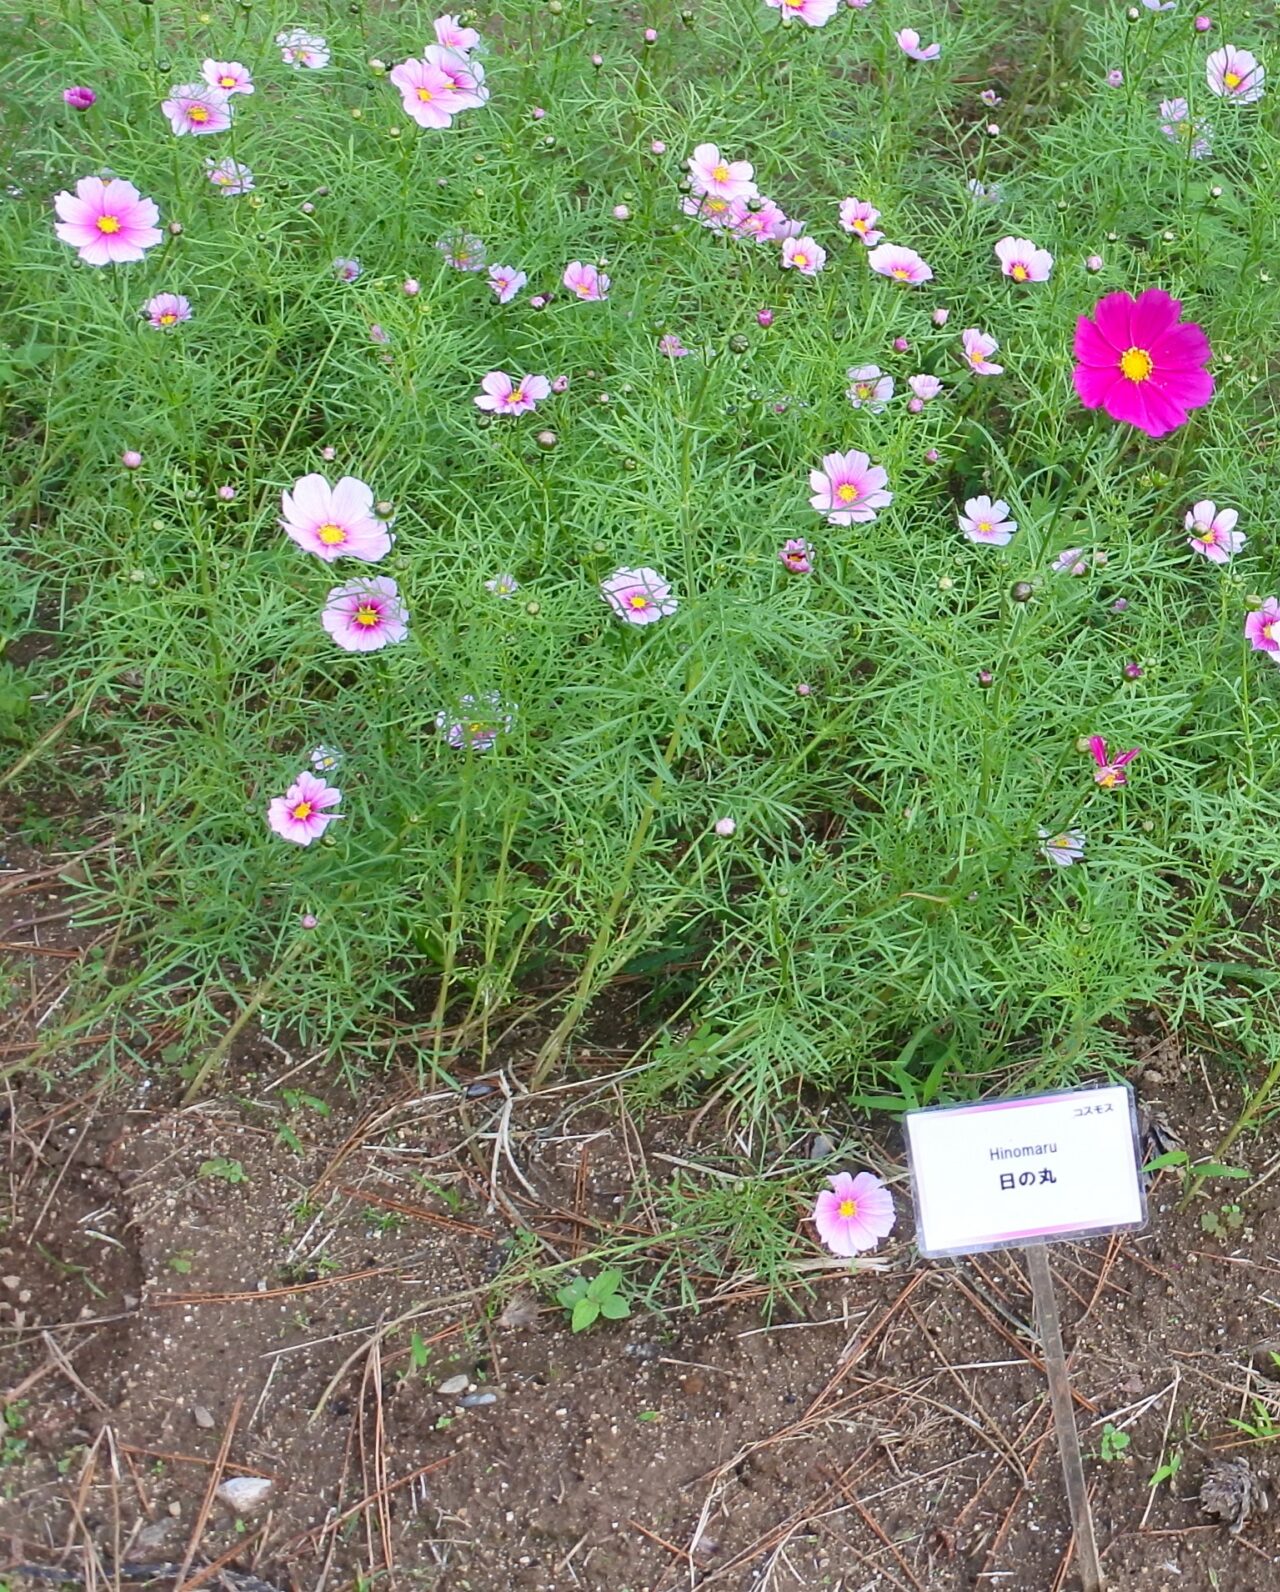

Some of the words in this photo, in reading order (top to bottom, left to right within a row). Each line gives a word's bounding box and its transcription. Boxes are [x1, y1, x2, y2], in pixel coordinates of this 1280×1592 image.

[1073, 1103, 1114, 1117] コスモス
[989, 1142, 1058, 1161] Hinomaru
[999, 1167, 1057, 1190] 日の丸
